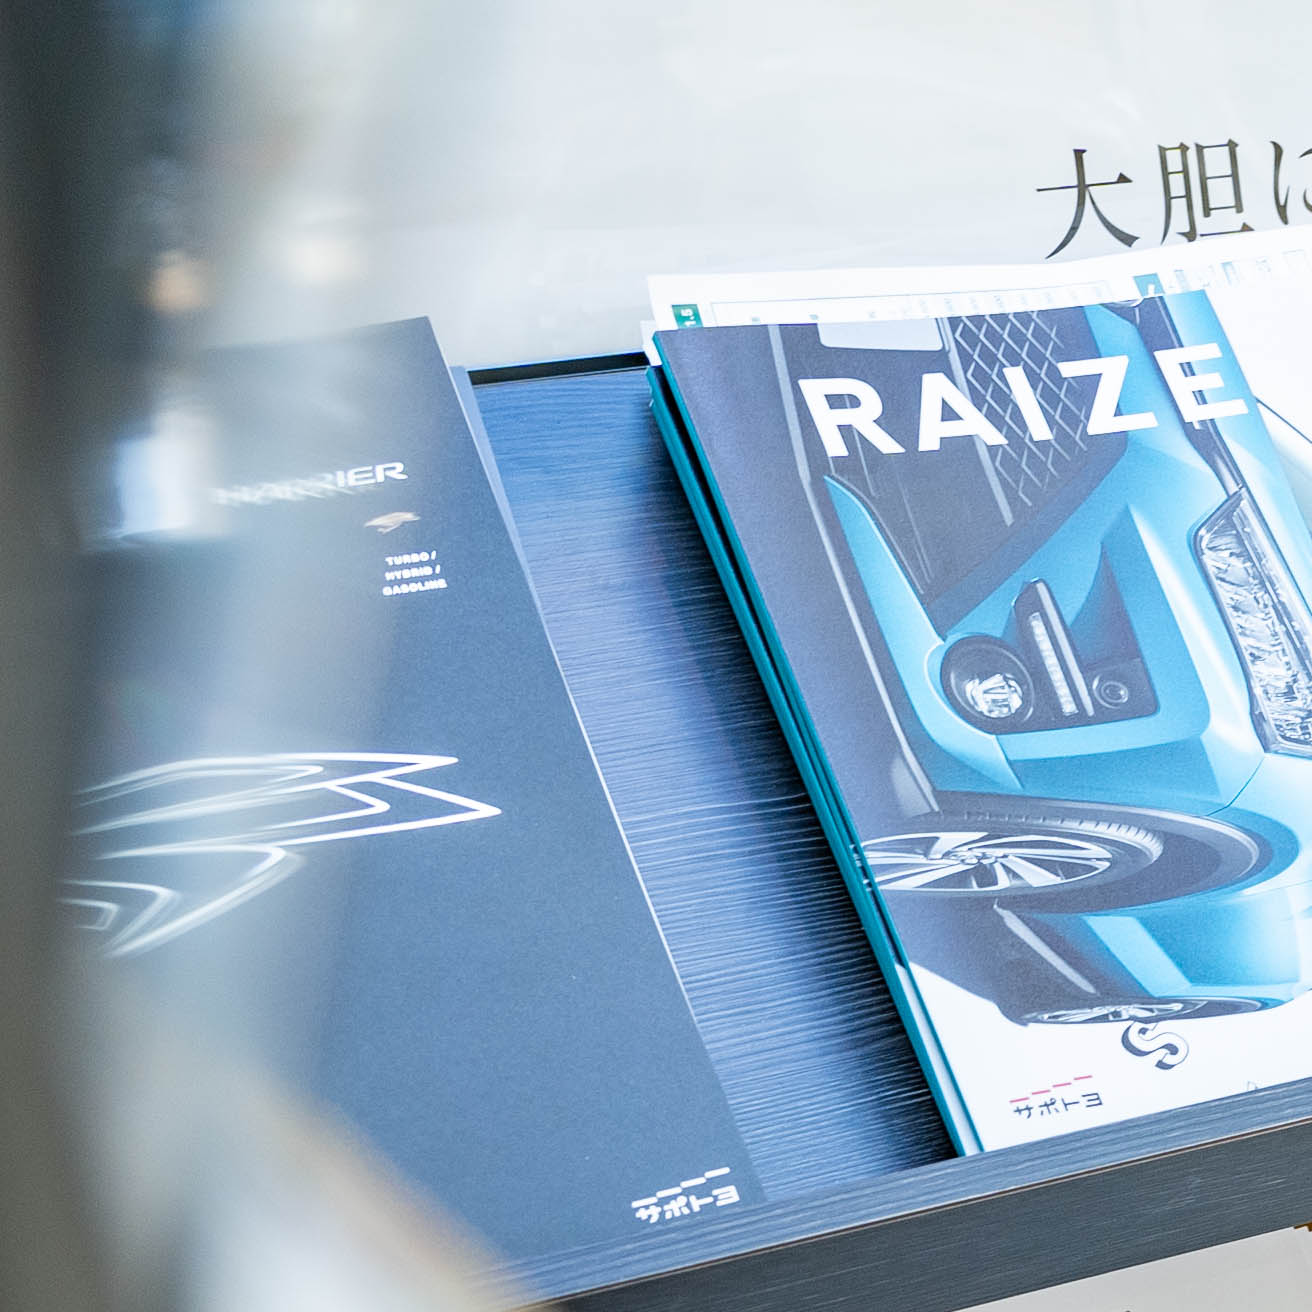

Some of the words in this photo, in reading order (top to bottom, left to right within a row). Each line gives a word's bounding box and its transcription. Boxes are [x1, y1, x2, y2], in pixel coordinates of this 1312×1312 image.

[797, 342, 1249, 458] RAIZE
[385, 552, 428, 566] TURBO
[382, 578, 447, 596] GASOLINE
[1013, 1092, 1103, 1119] サポトヨ
[635, 1184, 740, 1223] サポトヨ
